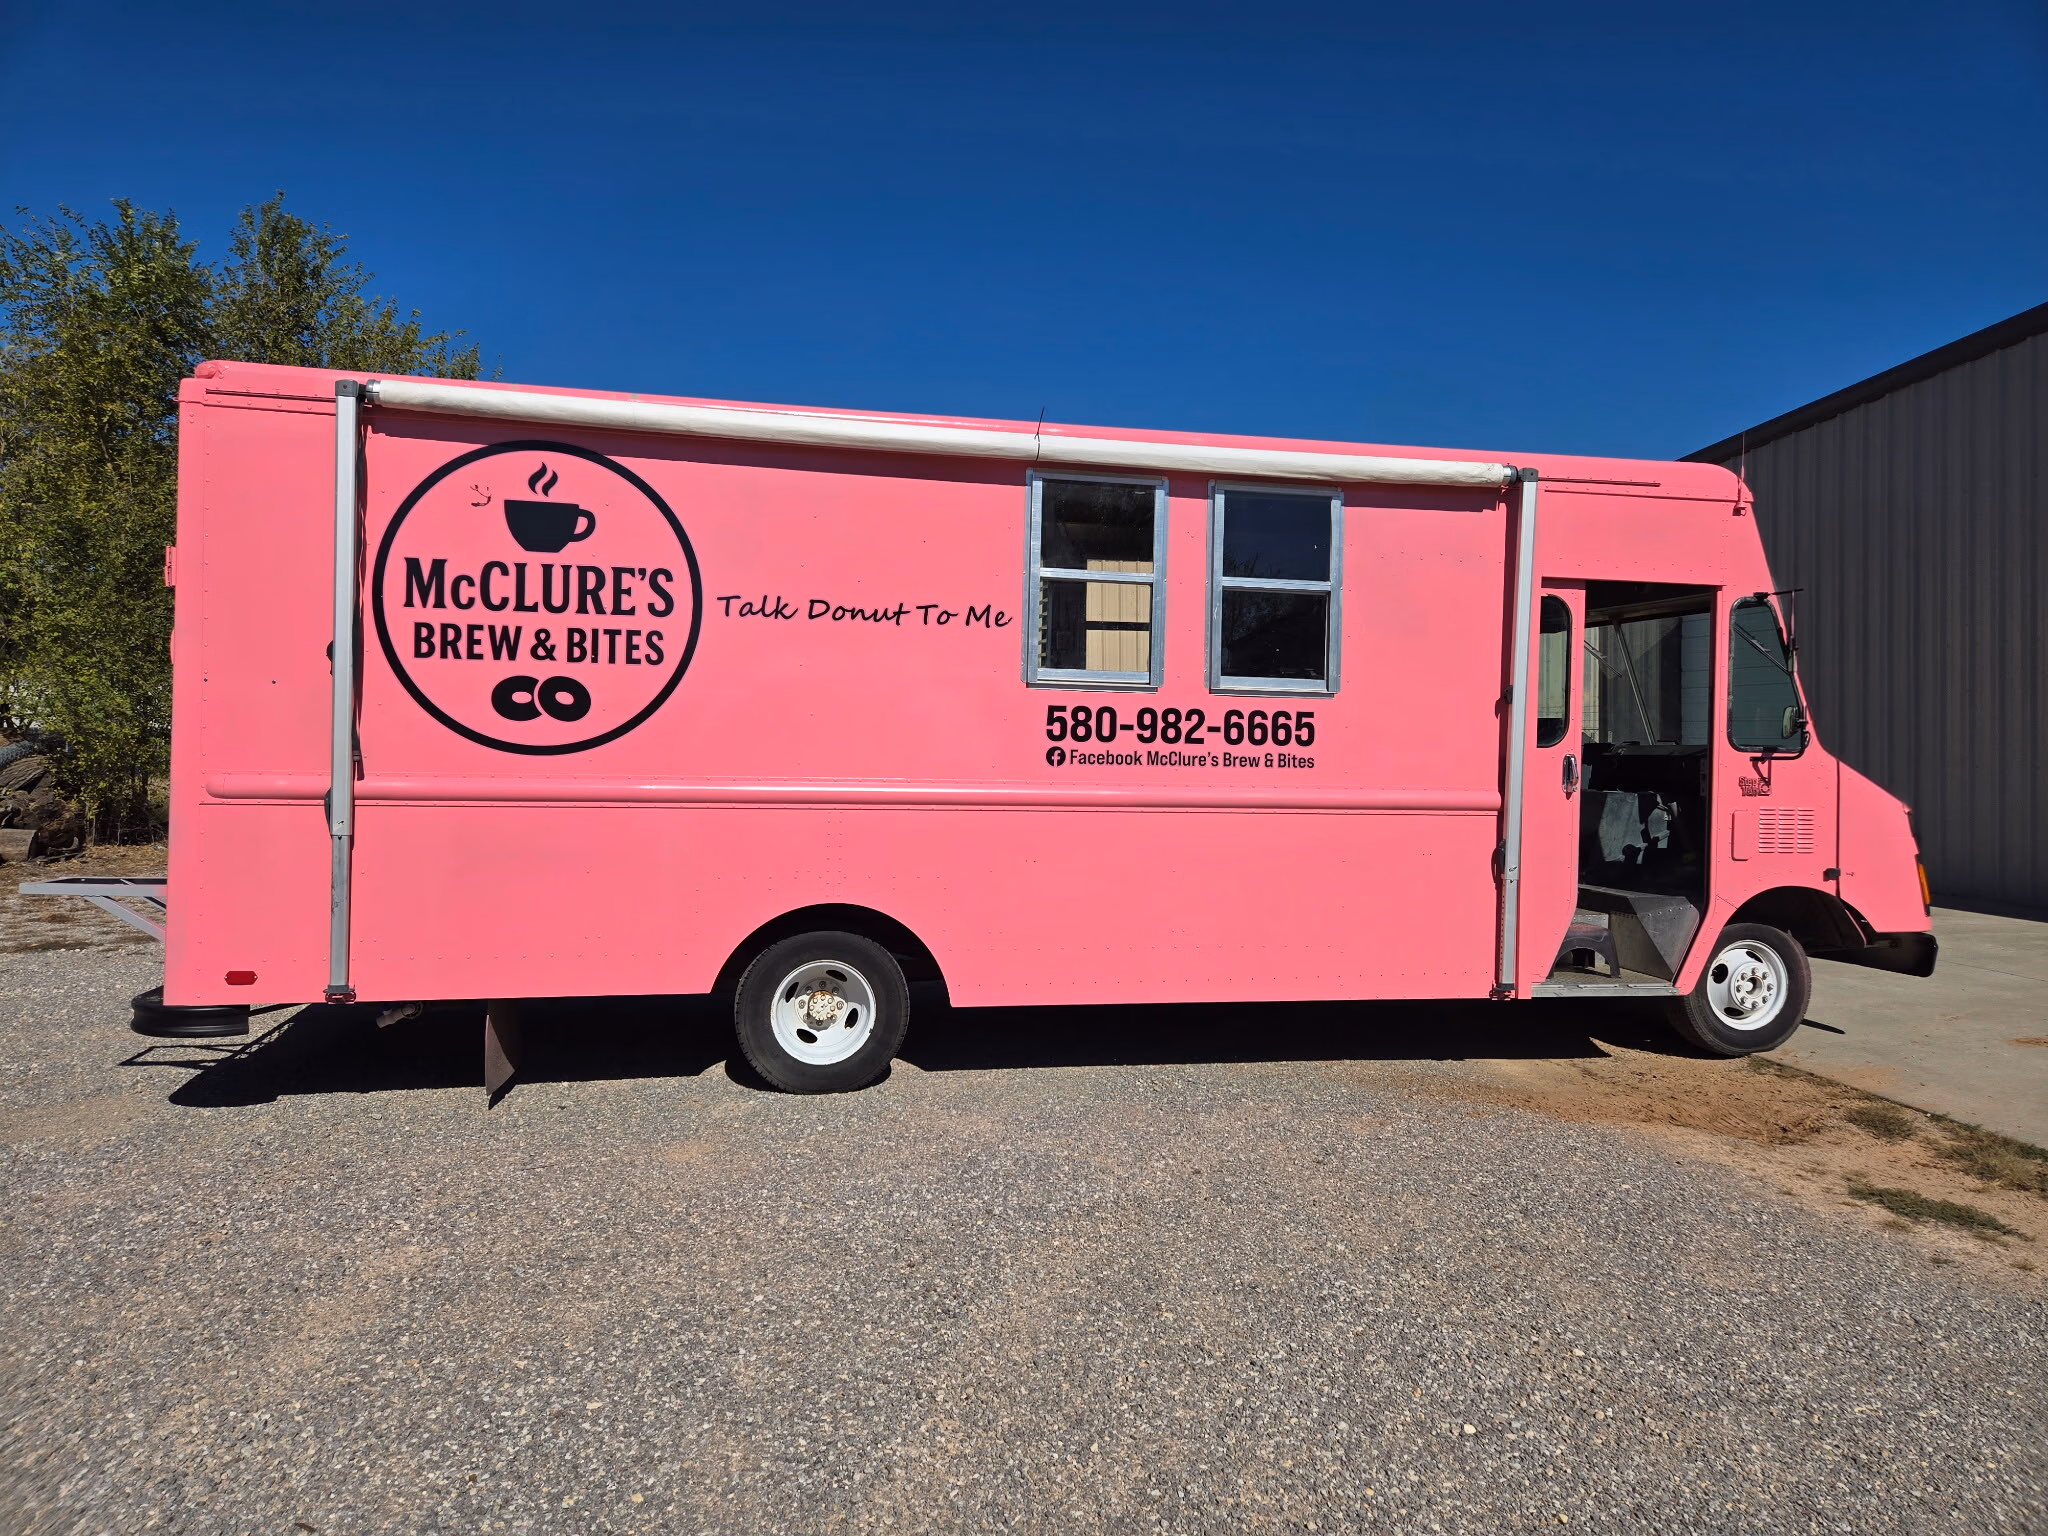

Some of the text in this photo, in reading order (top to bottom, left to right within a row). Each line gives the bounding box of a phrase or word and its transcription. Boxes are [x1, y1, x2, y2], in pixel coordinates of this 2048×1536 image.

[403, 556, 676, 618] McCLURE'S
[716, 594, 1013, 629] Talk Donut To Me
[413, 621, 665, 666] BREW & BITES
[1046, 704, 1315, 747] 580-982-6665
[1070, 749, 1315, 769] Facebook McClure's Brew & Bites
